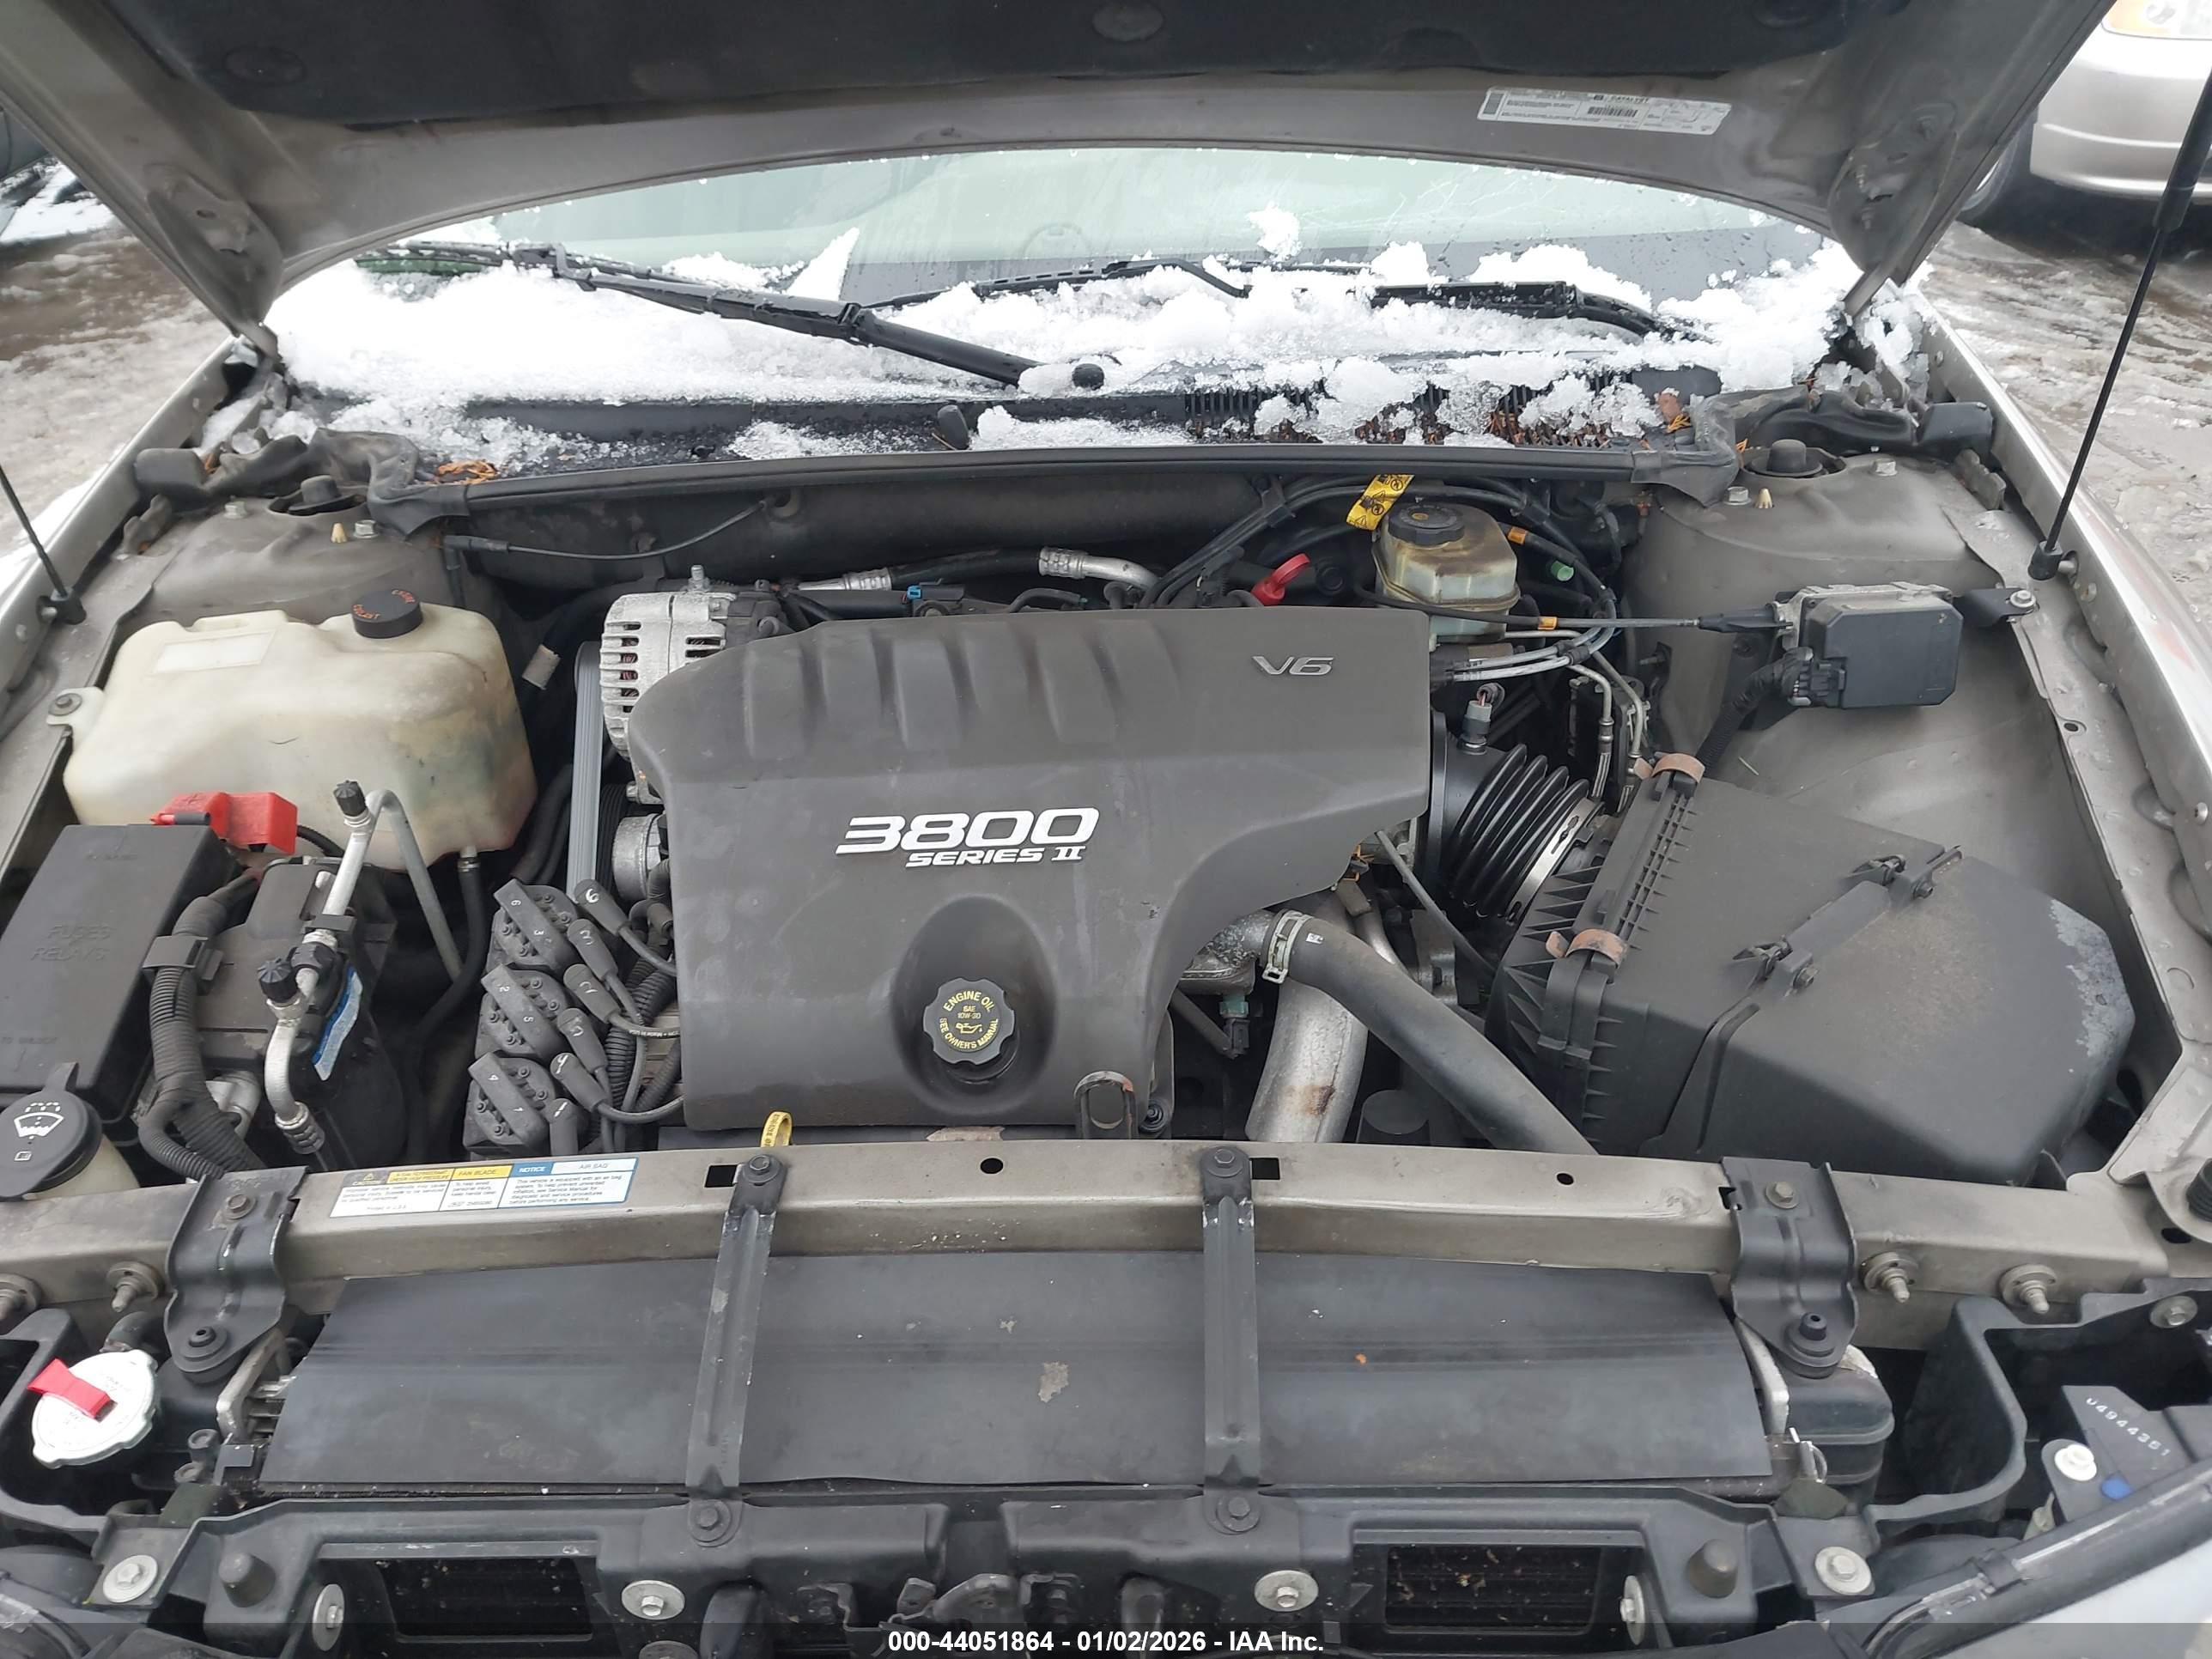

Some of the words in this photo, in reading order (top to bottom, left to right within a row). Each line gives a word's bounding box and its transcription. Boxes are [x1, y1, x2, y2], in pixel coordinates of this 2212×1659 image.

[1252, 655, 1334, 676] V6
[835, 807, 1100, 855] 3800
[905, 847, 1046, 868] SERIES
[1050, 845, 1086, 862] II
[943, 990, 982, 1012] ENGINE
[981, 996, 996, 1013] OIL
[939, 1018, 950, 1033] SEE
[977, 1018, 1000, 1047] MANUAL
